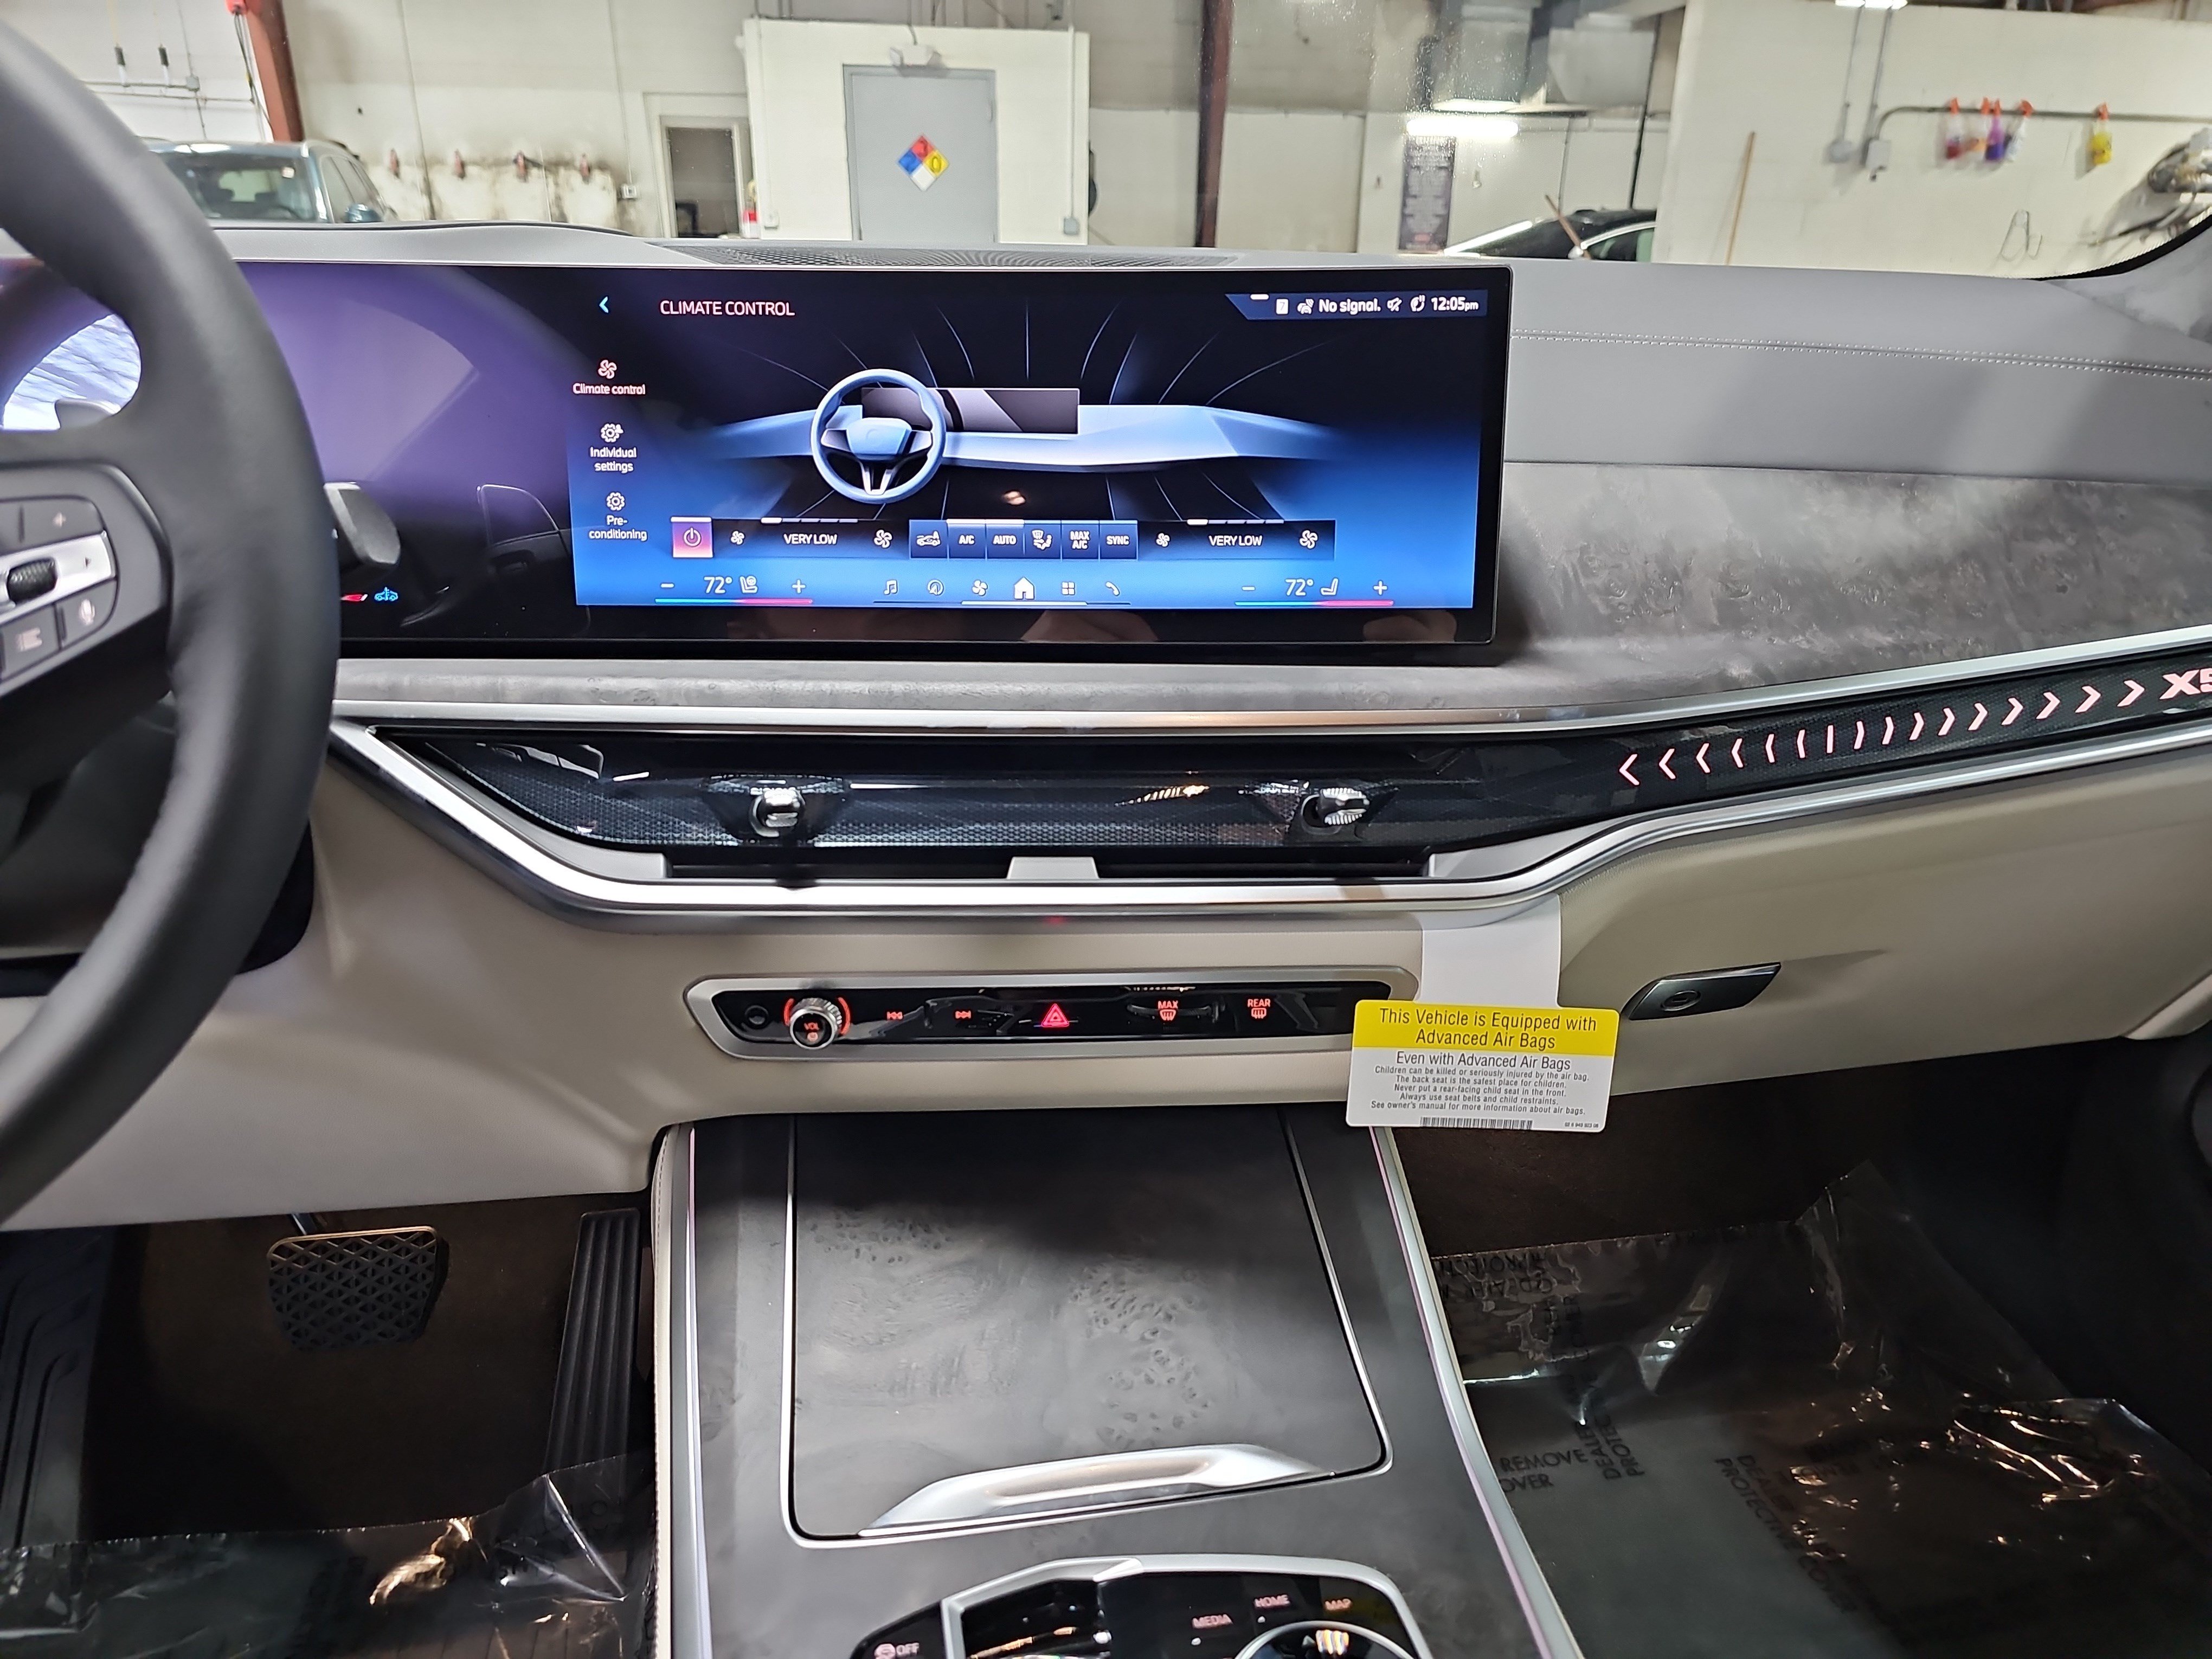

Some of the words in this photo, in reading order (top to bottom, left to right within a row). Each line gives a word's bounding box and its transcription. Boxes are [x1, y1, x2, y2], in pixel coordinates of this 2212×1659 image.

[660, 300, 722, 315] CLIMATE
[725, 301, 795, 317] CONTROL
[1319, 298, 1337, 312] No
[1339, 298, 1381, 314] signal.
[1431, 297, 1479, 312] 12:05pm
[573, 383, 610, 395] Climate
[612, 384, 646, 395] control
[590, 446, 637, 459] Individual
[594, 461, 634, 473] settings
[606, 515, 628, 526] Pre-
[588, 529, 648, 542] conditioning
[783, 533, 812, 545] VERY
[813, 533, 838, 545] LOW
[959, 535, 975, 545] A/C
[993, 535, 1017, 545] AUTO
[1070, 531, 1090, 541] MAX
[1107, 535, 1129, 545] SYNC
[1208, 535, 1238, 546] VERY
[1239, 535, 1263, 546] LOW
[1072, 541, 1088, 550] A/C
[704, 577, 732, 594] 72°
[1285, 578, 1314, 596] 72°
[1158, 1000, 1179, 1009] MAX
[1248, 998, 1270, 1007] REAR
[1380, 1008, 1410, 1024] This
[1416, 1009, 1468, 1026] Vehicle
[1474, 1011, 1486, 1026] is
[1491, 1012, 1560, 1031] Equipped
[1566, 1016, 1596, 1031] with
[1416, 1028, 1488, 1046] Advanced
[1493, 1032, 1515, 1046] Air
[1520, 1032, 1555, 1051] Bags
[1397, 1051, 1425, 1064] Even
[1430, 1052, 1454, 1065] with
[1458, 1053, 1516, 1068] Advanced
[1520, 1056, 1538, 1069] Air
[1541, 1056, 1571, 1072] Bags
[1375, 1065, 1406, 1073] Children
[1469, 1069, 1504, 1078] seriously
[1535, 1071, 1545, 1080] by
[1547, 1071, 1558, 1079] the
[1573, 1072, 1589, 1082] bag.
[1473, 1077, 1496, 1085] safest
[1498, 1078, 1518, 1086] place
[1534, 1079, 1566, 1088] children.
[1418, 1084, 1431, 1092] put
[1439, 1085, 1481, 1094] rear-facing
[1546, 1089, 1566, 1097] front.
[1400, 1092, 1426, 1101] Always
[1520, 1096, 1558, 1105] restraints.
[1371, 1101, 1385, 1109] See
[1483, 1104, 1527, 1112] information
[1566, 1107, 1585, 1115] bags.
[1500, 1449, 1588, 1472] REMOVE
[1254, 1594, 1291, 1608] HOME
[1324, 1598, 1352, 1611] MAP
[1192, 1614, 1233, 1629] MEDIA
[896, 1642, 919, 1656] OFF
